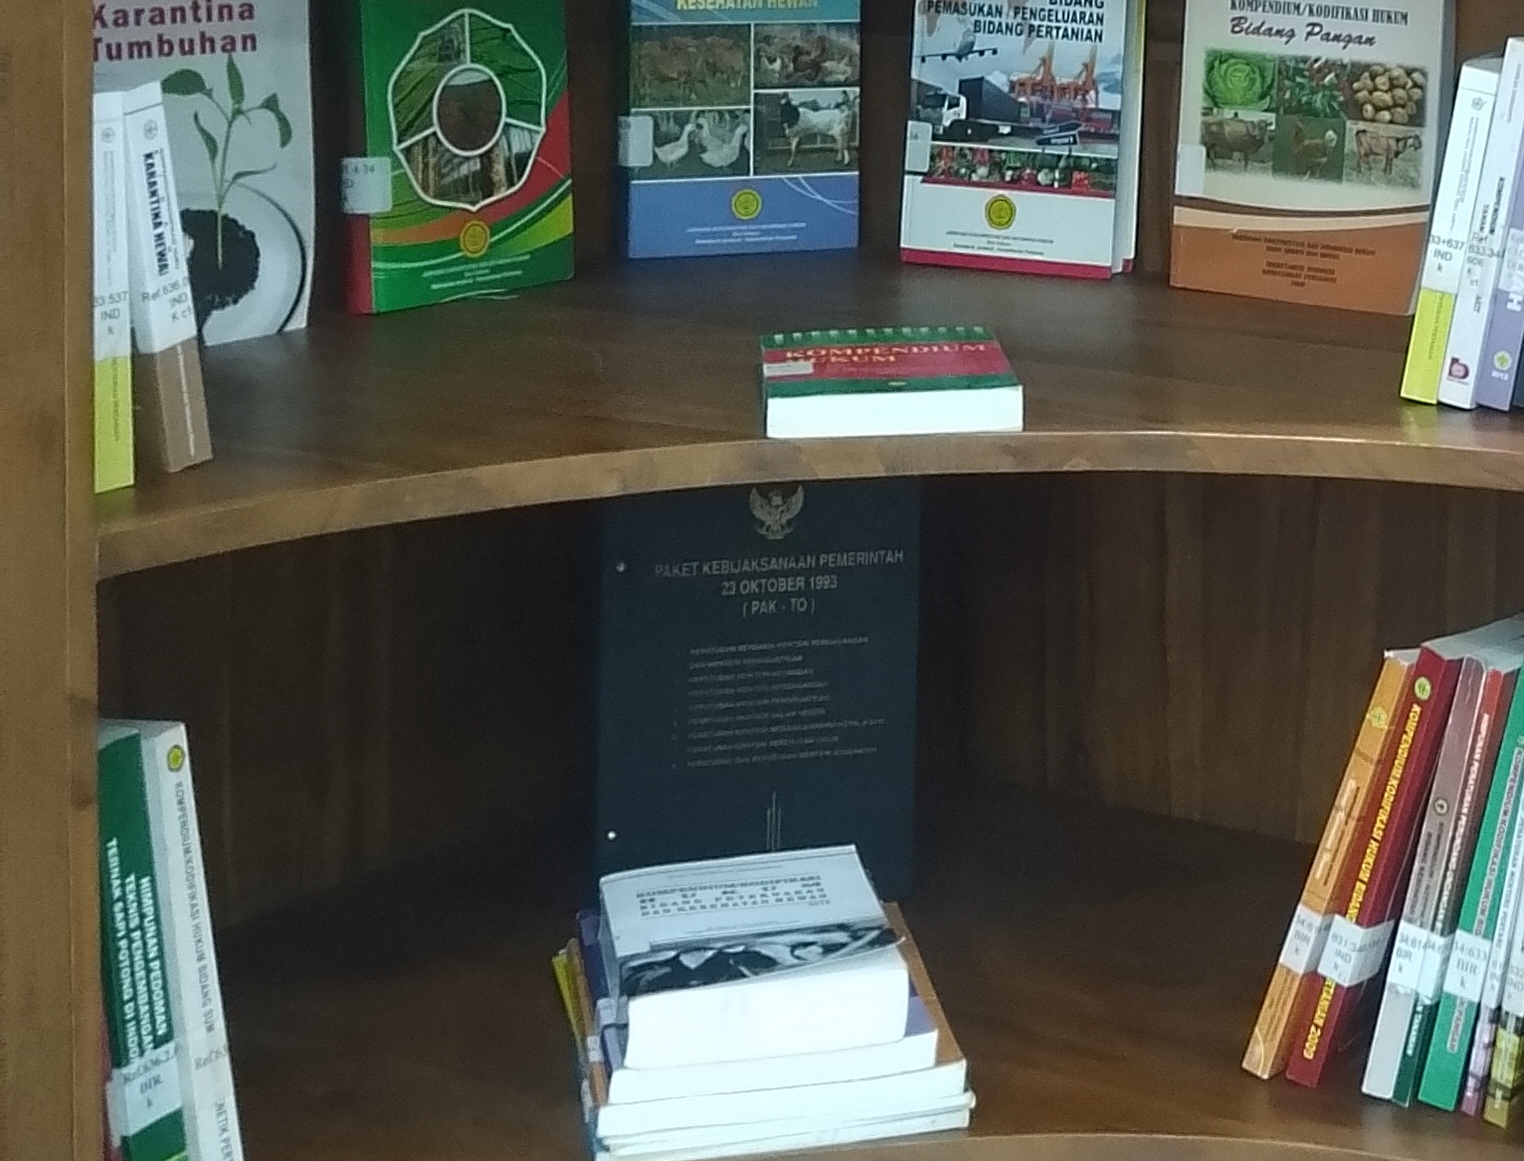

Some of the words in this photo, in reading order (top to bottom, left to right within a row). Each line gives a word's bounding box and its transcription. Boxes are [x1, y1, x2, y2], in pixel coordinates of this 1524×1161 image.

[927, 0, 1003, 18] PEMASUKAN
[1013, 6, 1104, 26] PENGELUARAN
[1372, 8, 1409, 27] HUKUM
[973, 20, 1024, 37] BIDANG
[1027, 24, 1103, 43] PERTANIAN
[1229, 16, 1297, 46] Bidang
[1303, 23, 1377, 49] Pangan
[92, 30, 258, 62] Tumbuhan
[1432, 247, 1453, 262] IND
[785, 343, 986, 359] KOMPENDIUM
[655, 562, 698, 578] PAKET
[701, 554, 817, 575] KEBIJAKSANAAN
[819, 549, 905, 570] PEMERINTAH
[739, 577, 806, 595] OKTOBER
[809, 574, 838, 590] 1993
[1300, 1023, 1323, 1060] 2009
